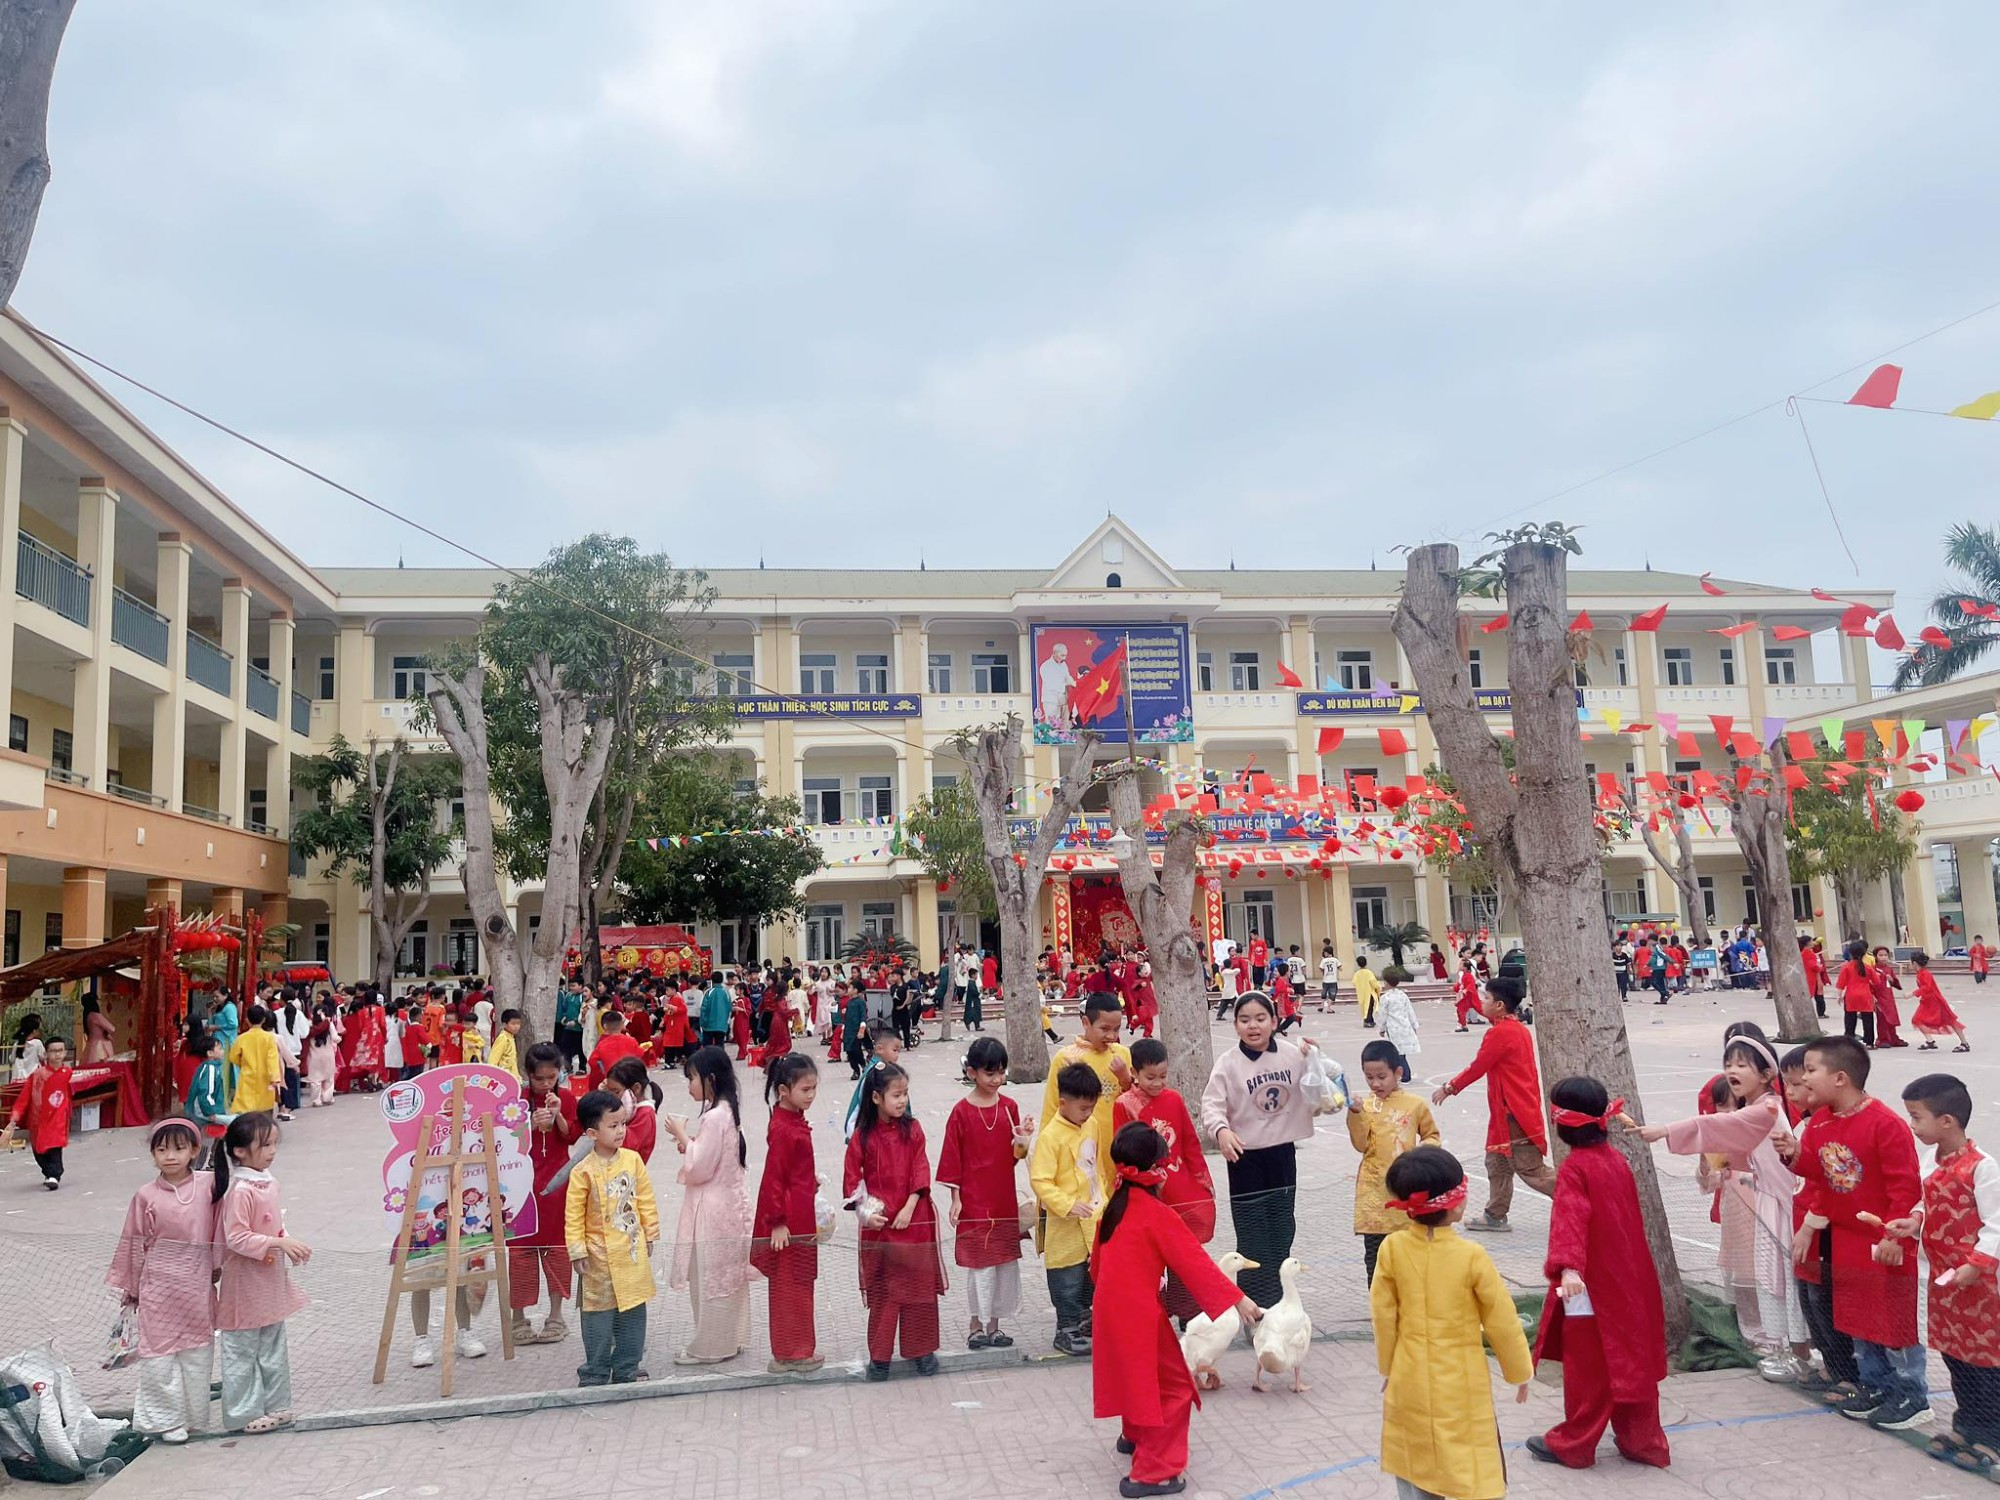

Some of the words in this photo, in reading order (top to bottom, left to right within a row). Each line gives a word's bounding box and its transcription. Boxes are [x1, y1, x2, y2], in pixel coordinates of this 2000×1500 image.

[757, 699, 779, 713] THÂN
[829, 701, 850, 712] SINH
[852, 698, 870, 712] TÍCH
[872, 699, 889, 713] CỰC
[1326, 697, 1336, 709] DÙ
[1337, 696, 1351, 709] KHÓ
[1493, 696, 1506, 708] DẠY
[1246, 1069, 1292, 1095] BIRTHDAY
